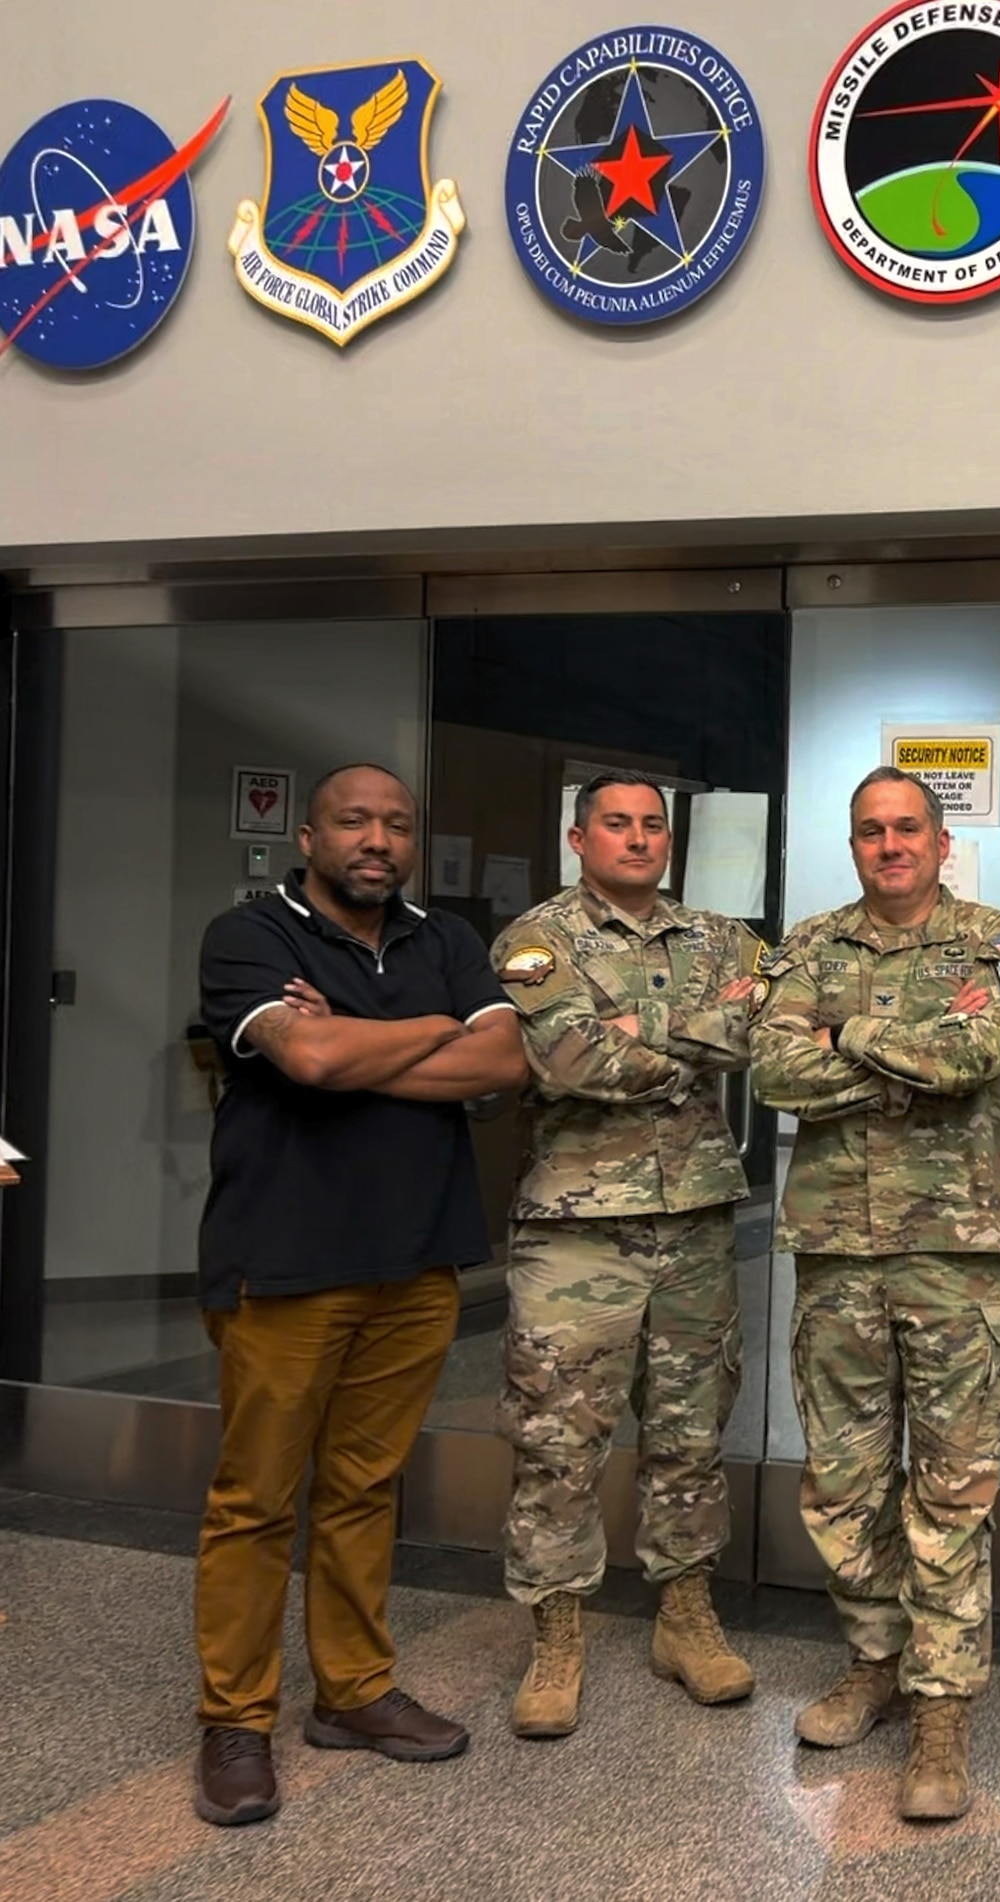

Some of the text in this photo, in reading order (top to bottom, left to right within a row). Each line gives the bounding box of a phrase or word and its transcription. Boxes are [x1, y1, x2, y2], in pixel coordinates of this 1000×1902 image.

[517, 33, 753, 154] RAPID CAPABILITIES OFFICE
[825, 38, 889, 141] MISSILE
[0, 199, 182, 268] NASA
[515, 180, 752, 312] OPUS DEI CUM PECUNIA ALIENUM EFFICEMUS
[841, 217, 948, 283] DEPARTMENT
[955, 264, 978, 281] OF
[241, 229, 450, 330] AIR FORCE GLOBAL STRIKE COMMAND
[249, 777, 278, 788] AED
[899, 747, 986, 763] SECURITY NOTICE
[923, 772, 943, 780] NOT
[945, 772, 975, 780] LEAVE
[933, 782, 956, 790] ITEM
[958, 782, 972, 790] OR
